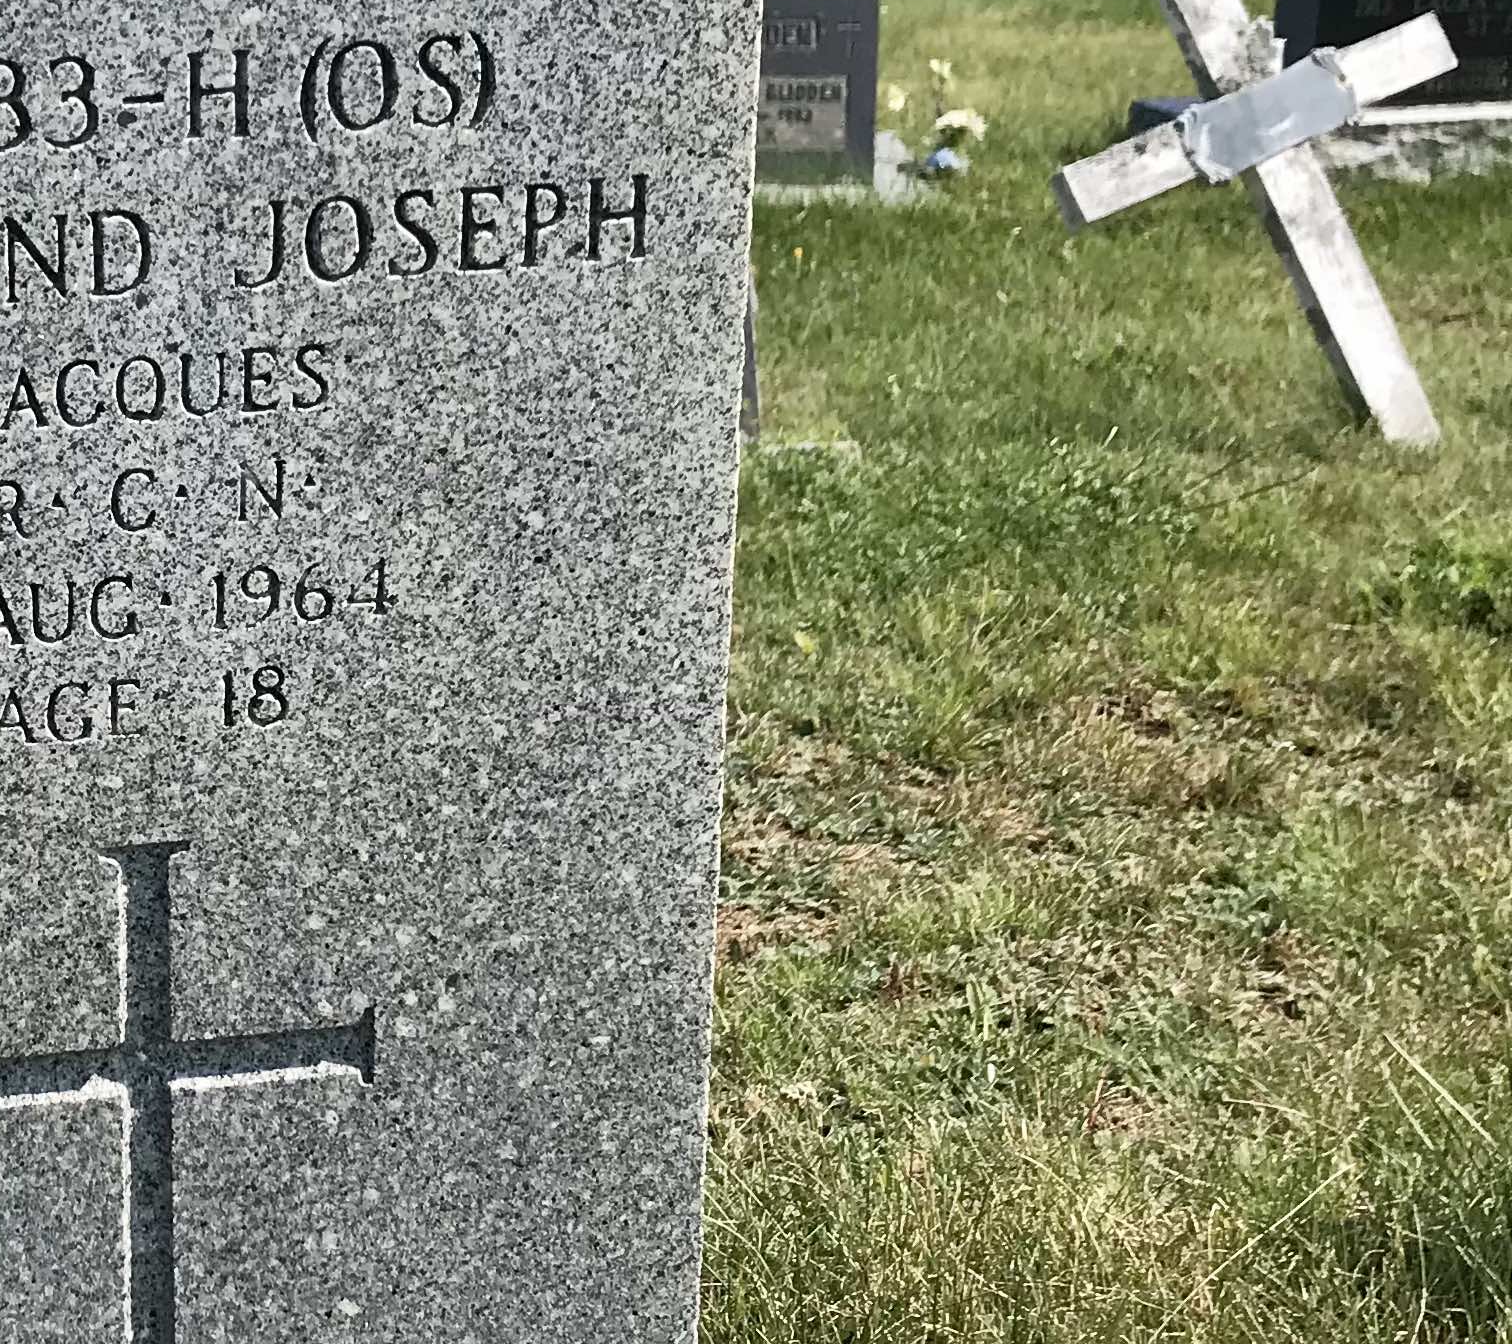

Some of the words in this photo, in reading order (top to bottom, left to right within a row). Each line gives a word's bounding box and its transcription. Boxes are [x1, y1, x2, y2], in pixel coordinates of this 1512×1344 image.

[299, 31, 497, 145] (OS)
[234, 174, 649, 290] JOSEPH
[209, 556, 397, 631] 1964
[222, 664, 290, 728] 18
